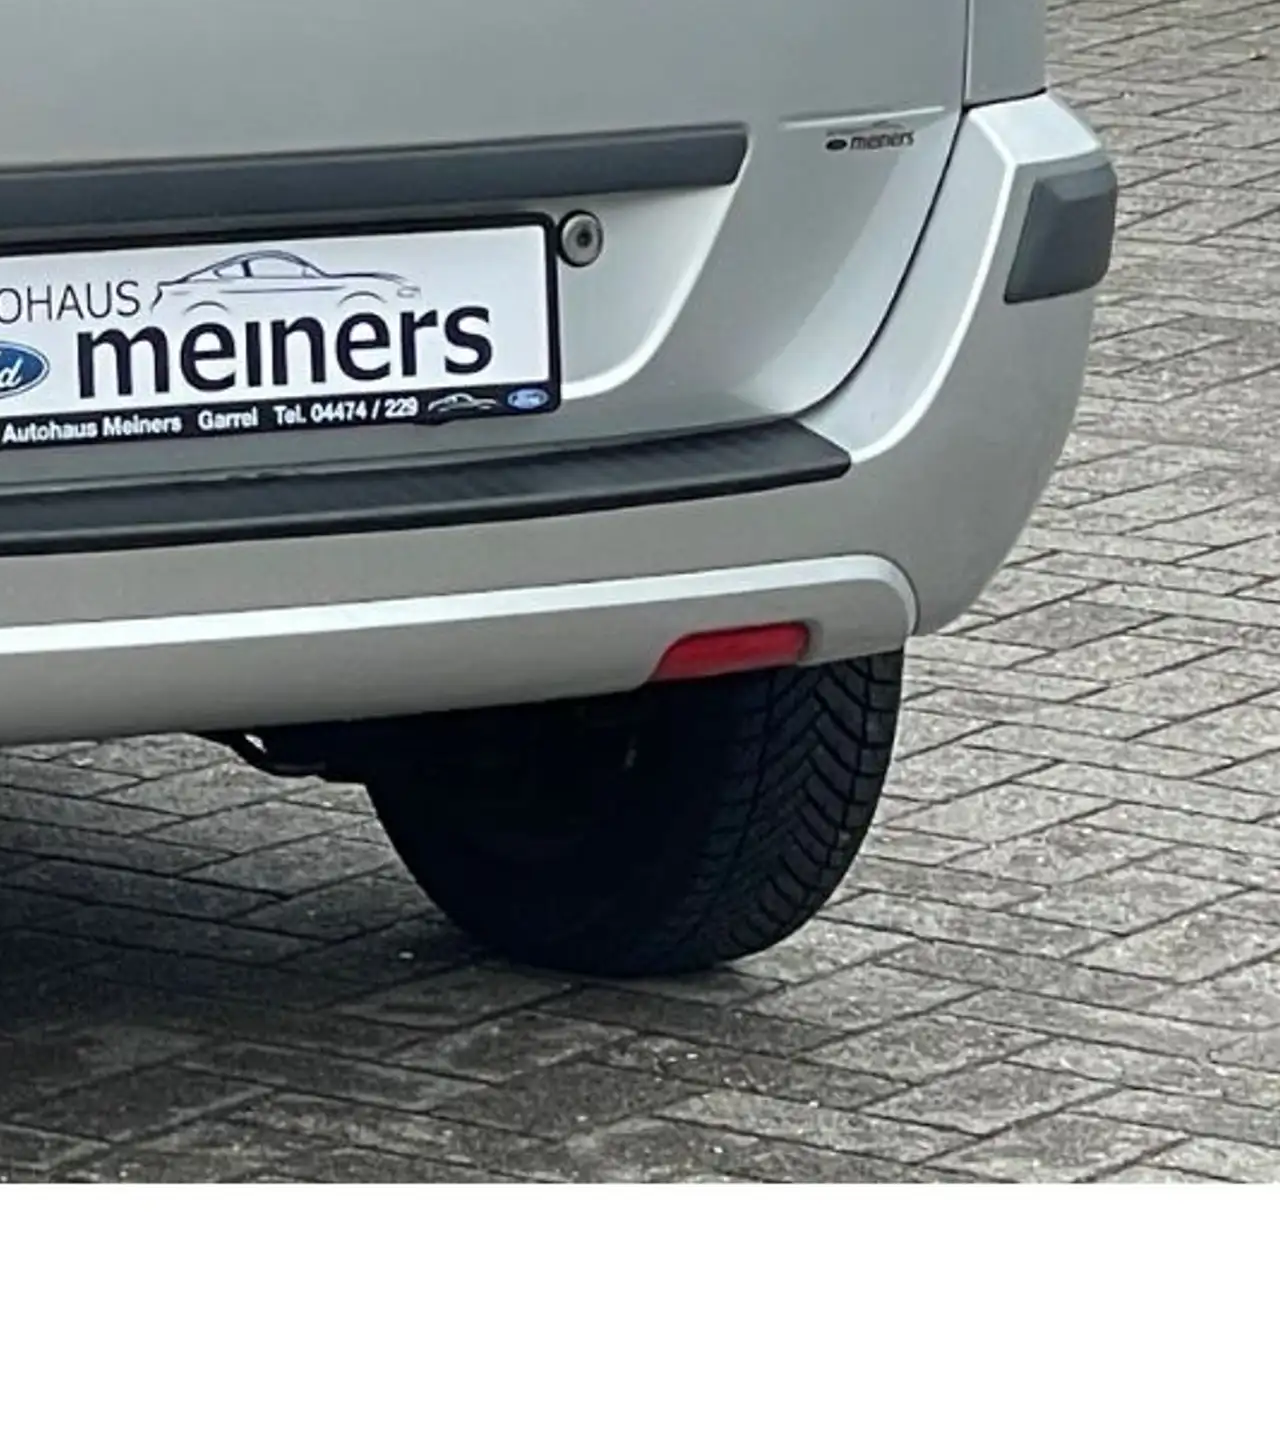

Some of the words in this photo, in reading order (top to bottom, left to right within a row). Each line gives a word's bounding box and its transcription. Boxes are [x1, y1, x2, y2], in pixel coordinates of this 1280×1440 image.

[77, 305, 494, 399] meiners
[2, 420, 98, 443] Autohaus
[102, 413, 182, 436] Meiners
[197, 405, 258, 431] Garrel
[273, 404, 307, 426] Tel.
[310, 400, 368, 423] 04474
[384, 396, 419, 419] 229
